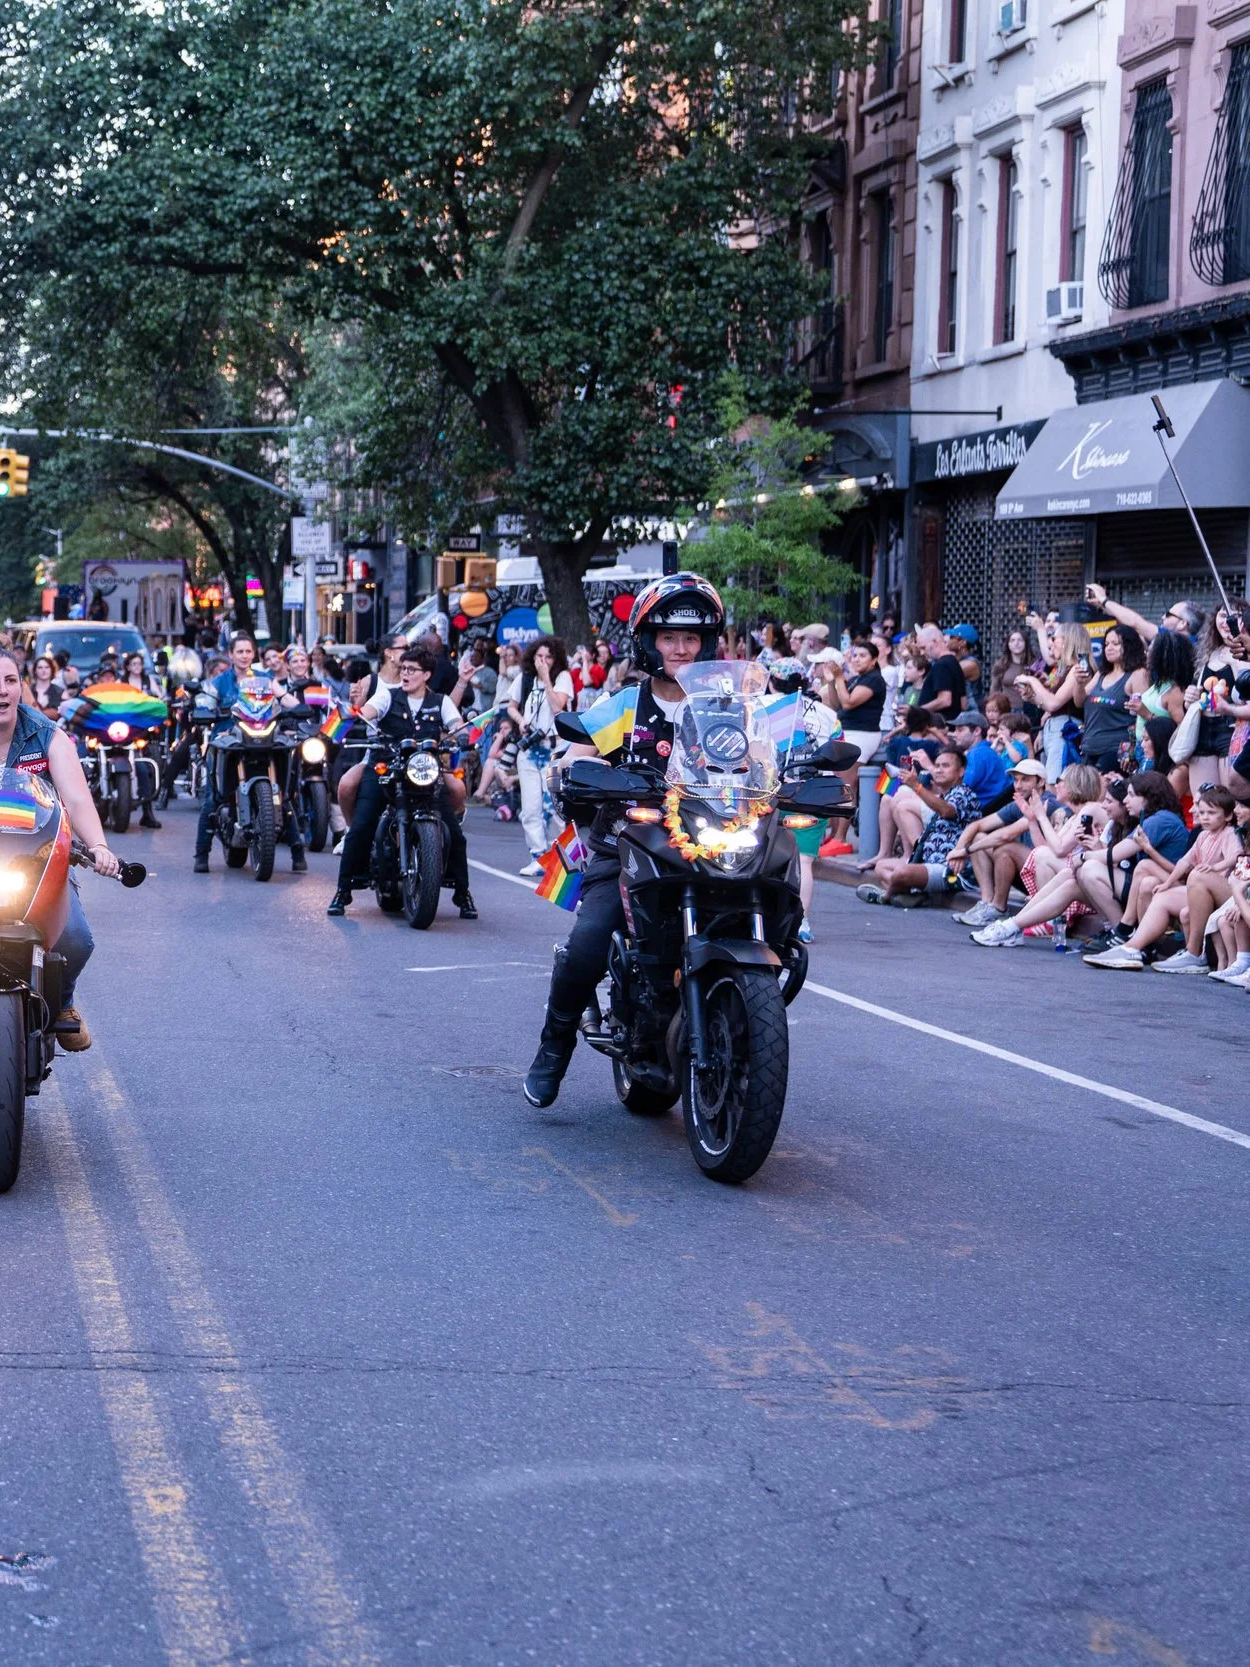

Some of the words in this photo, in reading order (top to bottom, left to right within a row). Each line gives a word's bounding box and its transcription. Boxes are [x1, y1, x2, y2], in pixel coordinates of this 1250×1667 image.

[934, 443, 949, 478] Les
[950, 437, 985, 477] Enfants
[986, 429, 1027, 471] Terribles
[673, 608, 696, 618] SHOEI
[19, 752, 43, 762] PRESIDENT
[17, 761, 47, 773] Savage
